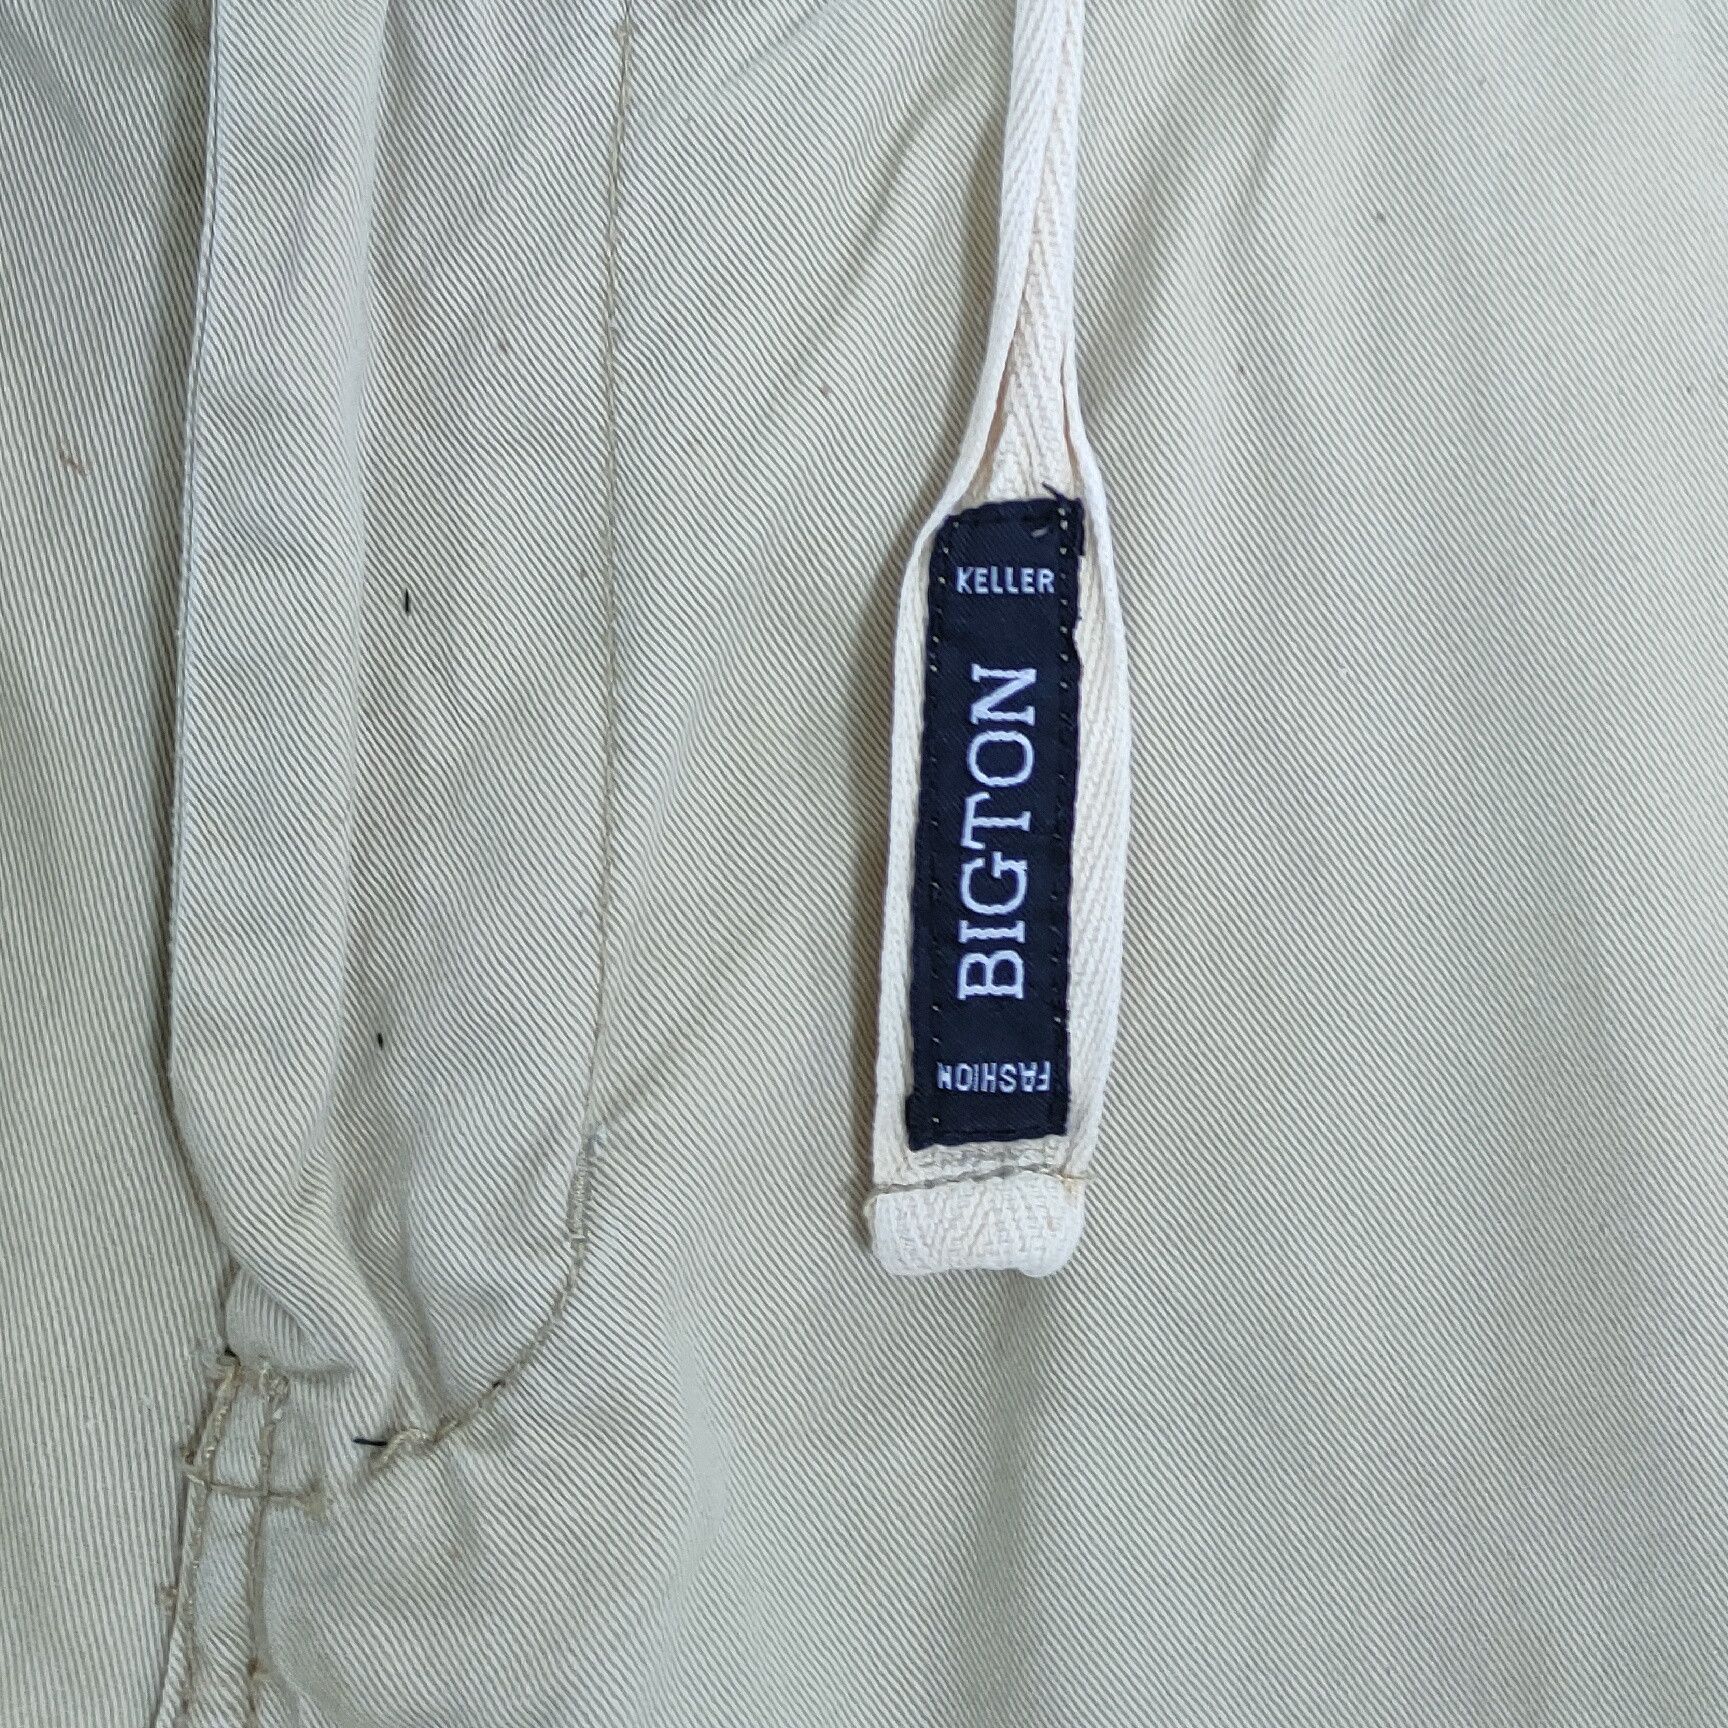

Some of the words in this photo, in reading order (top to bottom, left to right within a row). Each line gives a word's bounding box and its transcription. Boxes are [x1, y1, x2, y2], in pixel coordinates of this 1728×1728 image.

[955, 566, 1056, 595] KELLER
[957, 663, 1038, 1001] BIGTON
[935, 1060, 1051, 1093] FASHION
